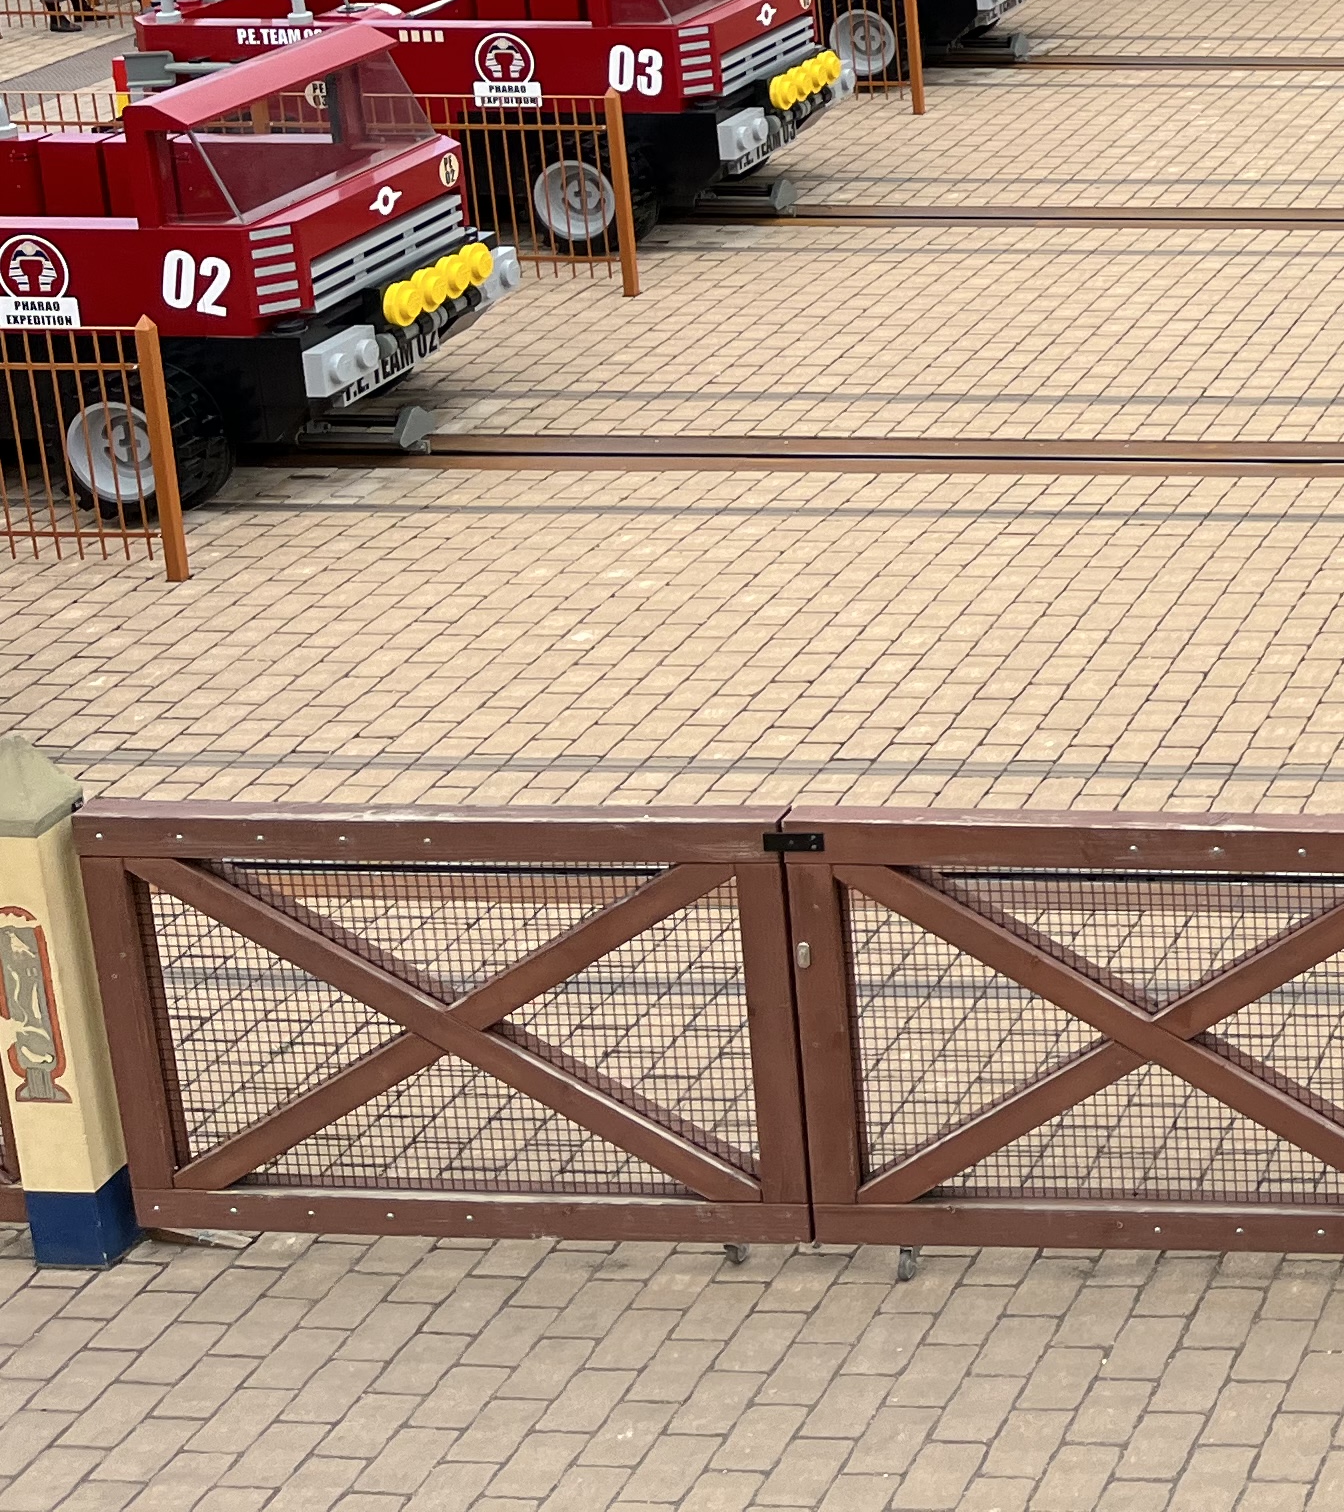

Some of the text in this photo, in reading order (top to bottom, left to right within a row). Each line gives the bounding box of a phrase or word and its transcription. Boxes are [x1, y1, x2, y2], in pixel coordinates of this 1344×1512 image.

[236, 28, 260, 45] P.E.
[260, 28, 301, 45] TEAM
[608, 45, 663, 96] 03
[163, 249, 231, 317] 02
[14, 301, 60, 311] PHARAO
[6, 315, 73, 325] EXPEDITION
